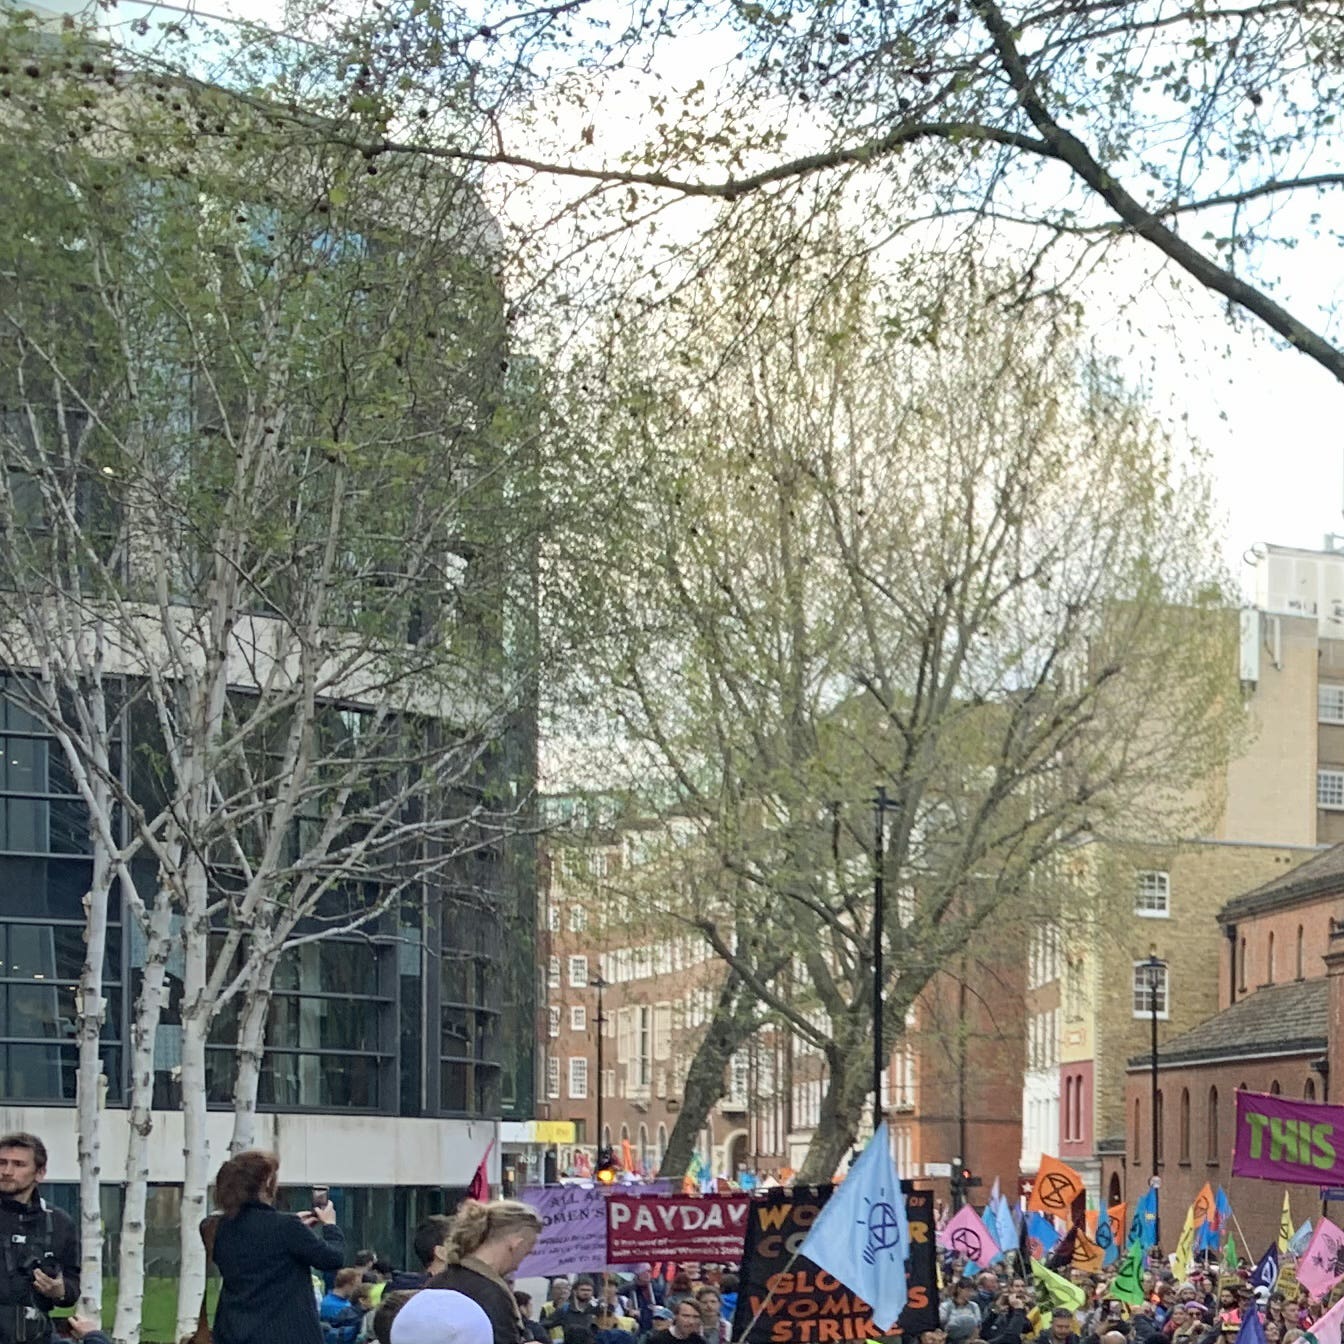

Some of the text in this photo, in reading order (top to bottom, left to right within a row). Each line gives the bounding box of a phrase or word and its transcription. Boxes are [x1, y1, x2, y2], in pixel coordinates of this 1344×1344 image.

[1246, 1112, 1336, 1170] THIS
[543, 1208, 604, 1226] OMEN'S
[610, 1202, 747, 1232] PAYDAY
